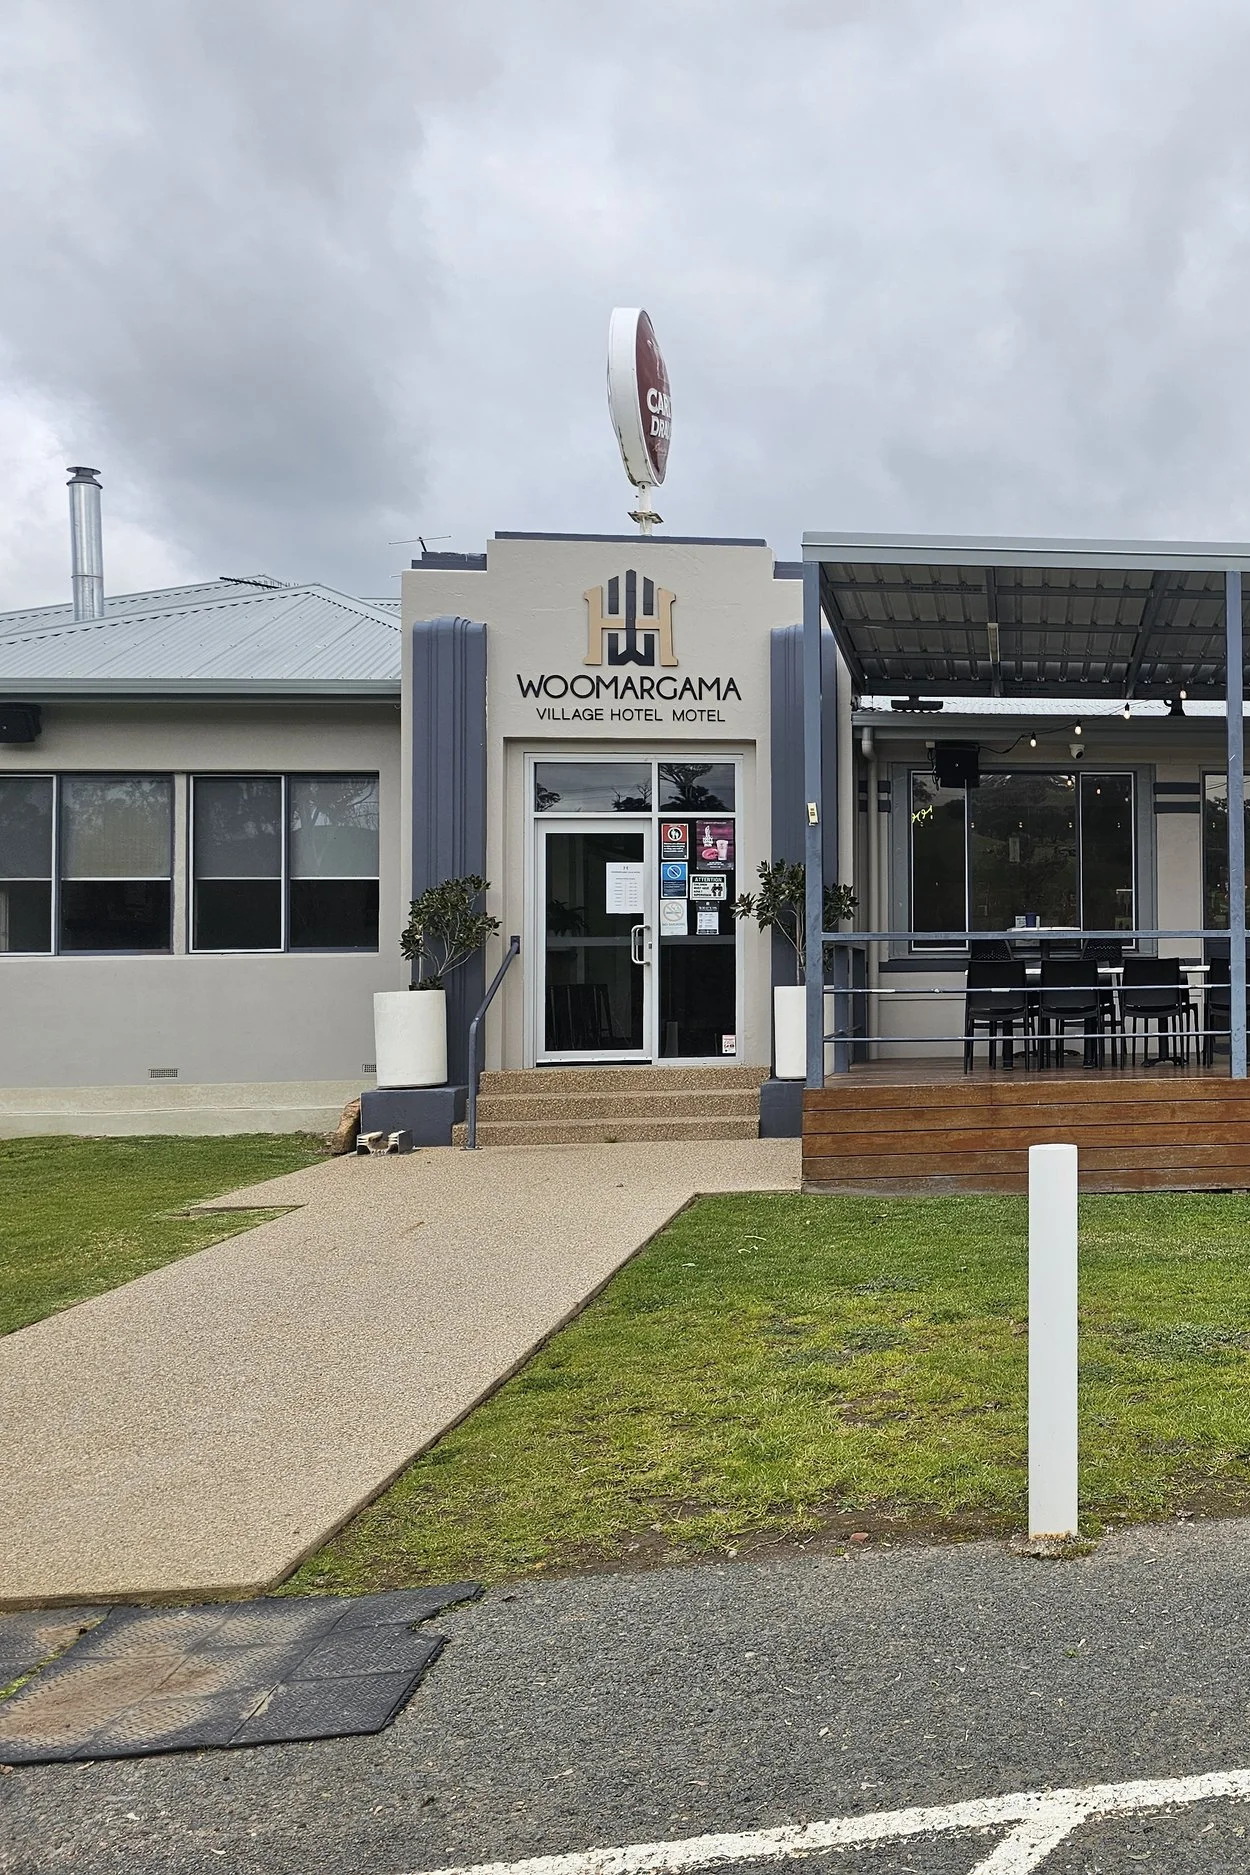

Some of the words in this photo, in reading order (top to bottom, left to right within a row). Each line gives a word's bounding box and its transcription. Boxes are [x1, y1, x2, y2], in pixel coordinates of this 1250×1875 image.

[516, 673, 742, 701] WOOMARGAMA
[536, 707, 604, 721] VILLAGE
[610, 708, 663, 722] HOTEL
[672, 709, 726, 722] MOTEL
